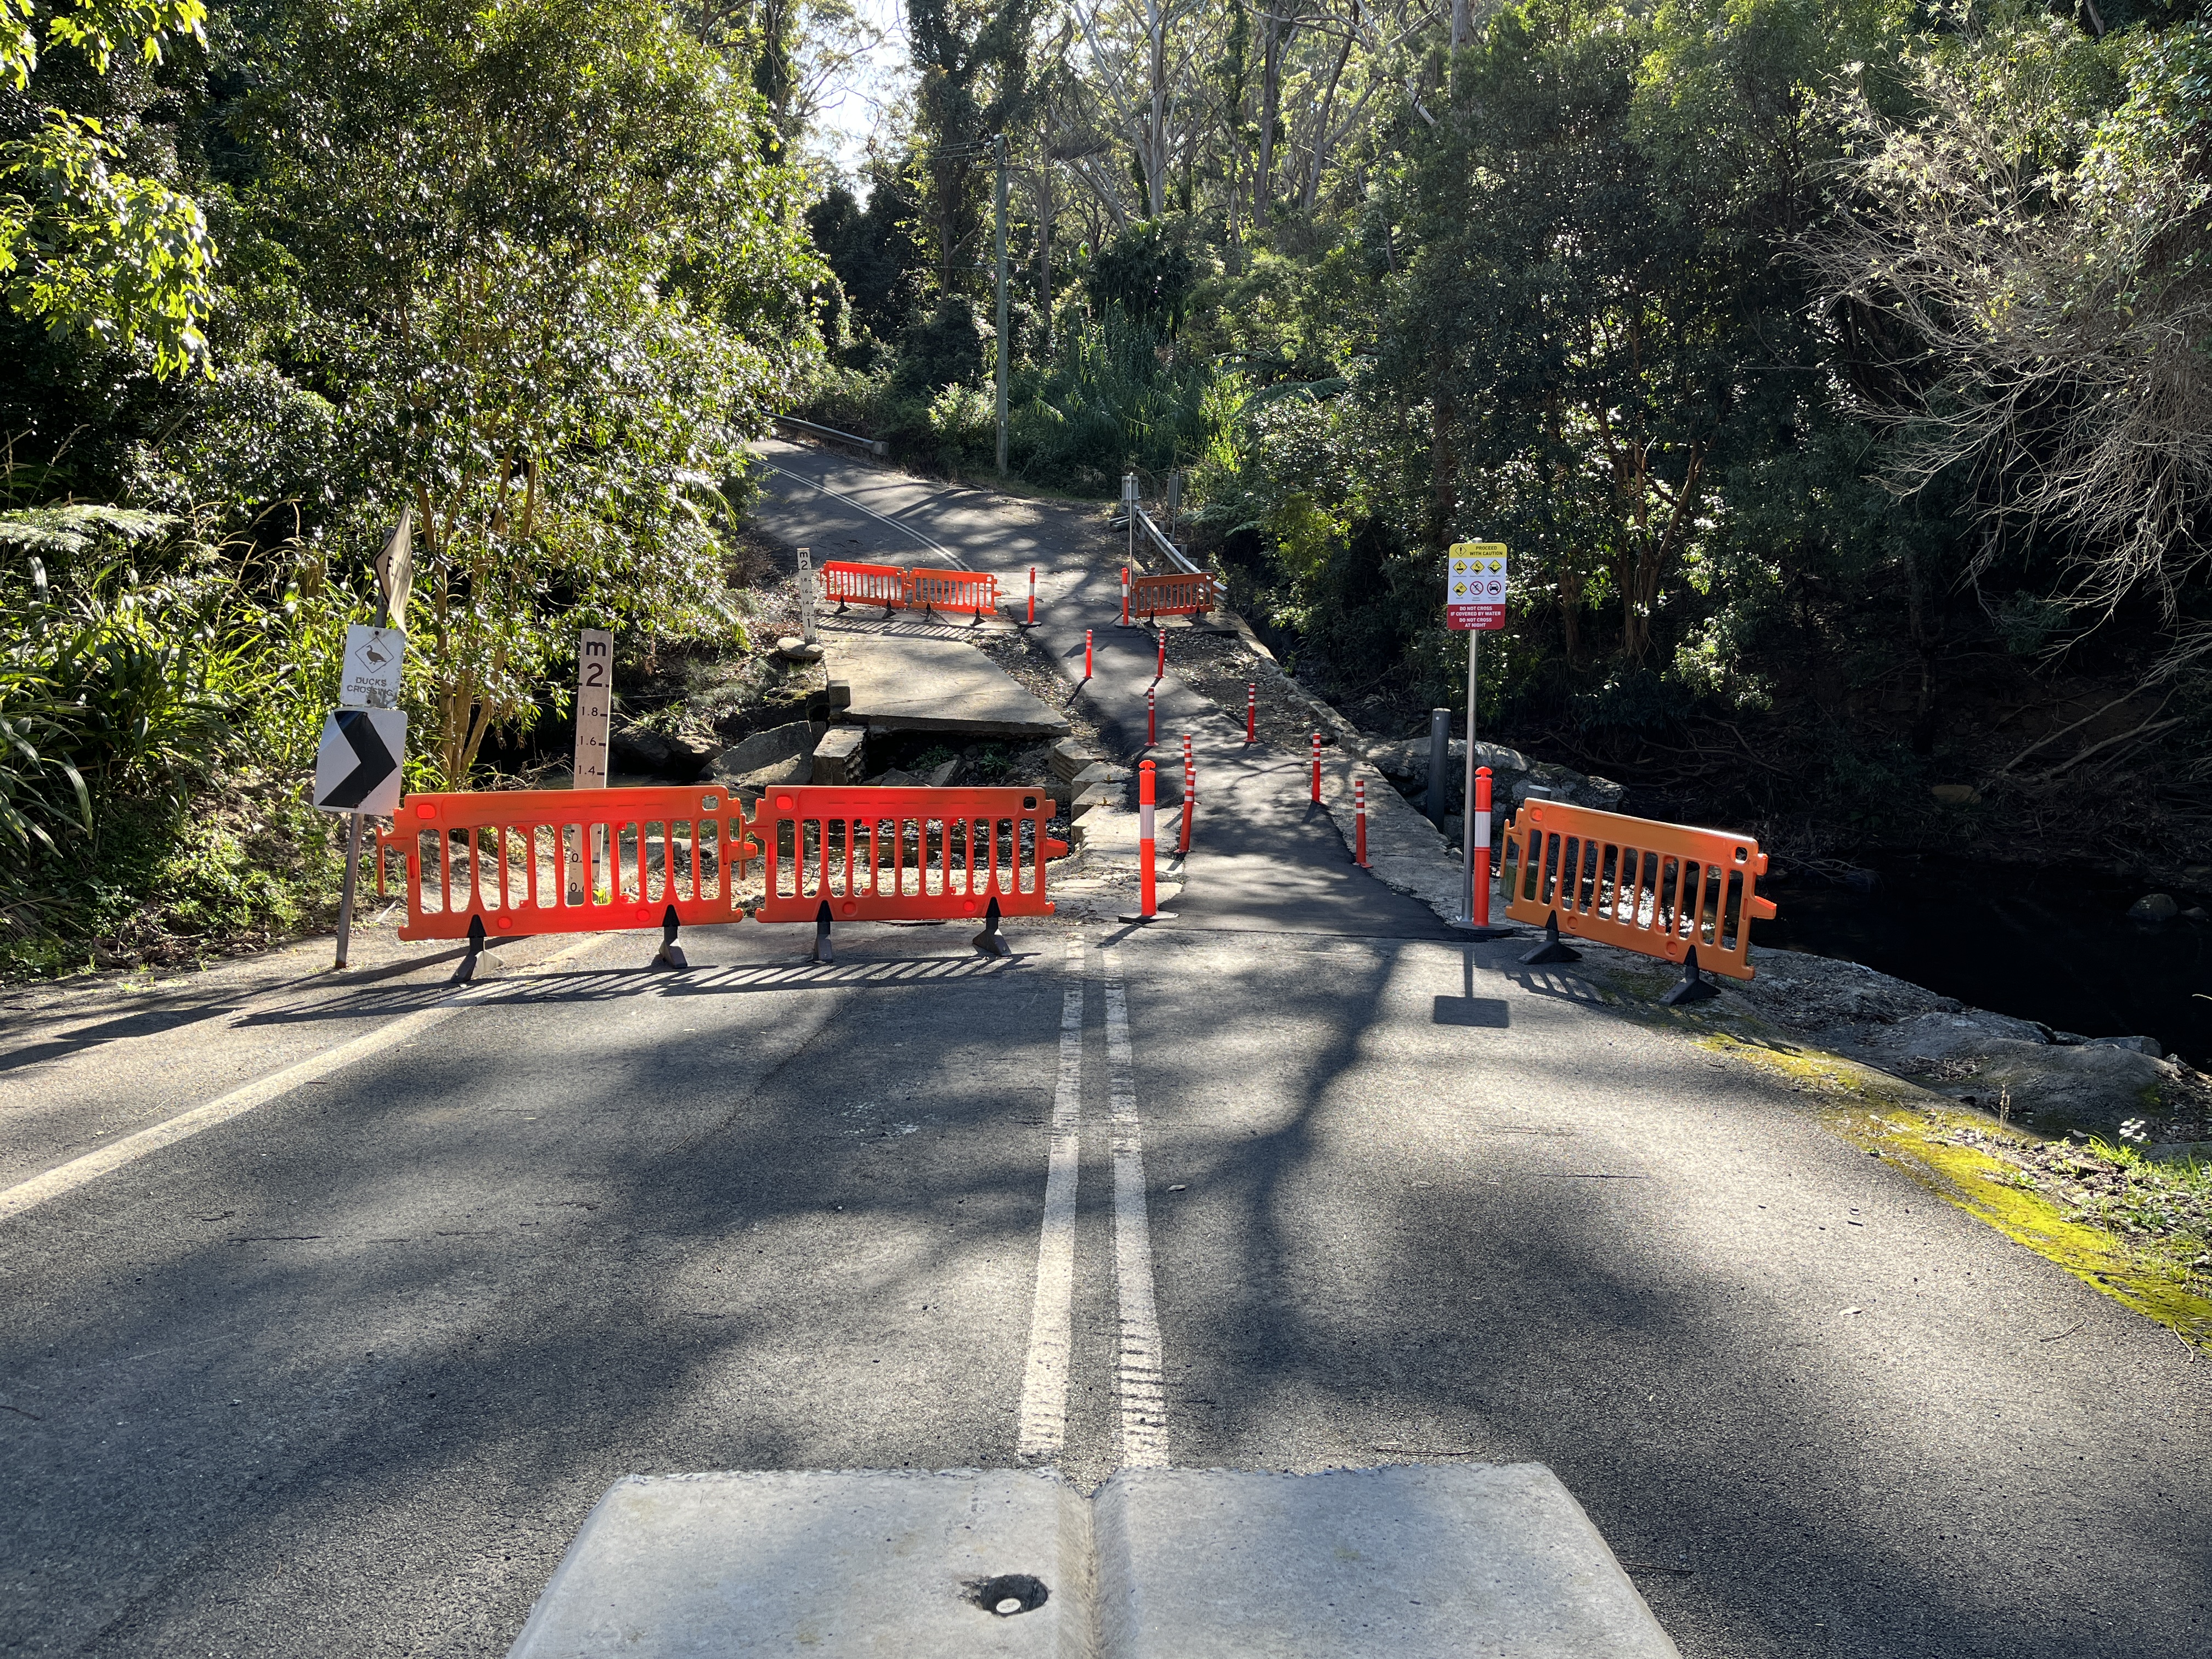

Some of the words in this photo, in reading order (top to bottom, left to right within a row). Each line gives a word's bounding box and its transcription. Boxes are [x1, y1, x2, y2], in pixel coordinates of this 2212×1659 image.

[801, 560, 808, 570] 2
[586, 641, 606, 656] m
[586, 663, 603, 687] 2
[356, 677, 386, 687] DUCKS
[347, 685, 393, 697] CROSSING
[582, 707, 597, 716] 1.8
[580, 736, 596, 746] 1.6
[579, 765, 595, 775] 1.4
